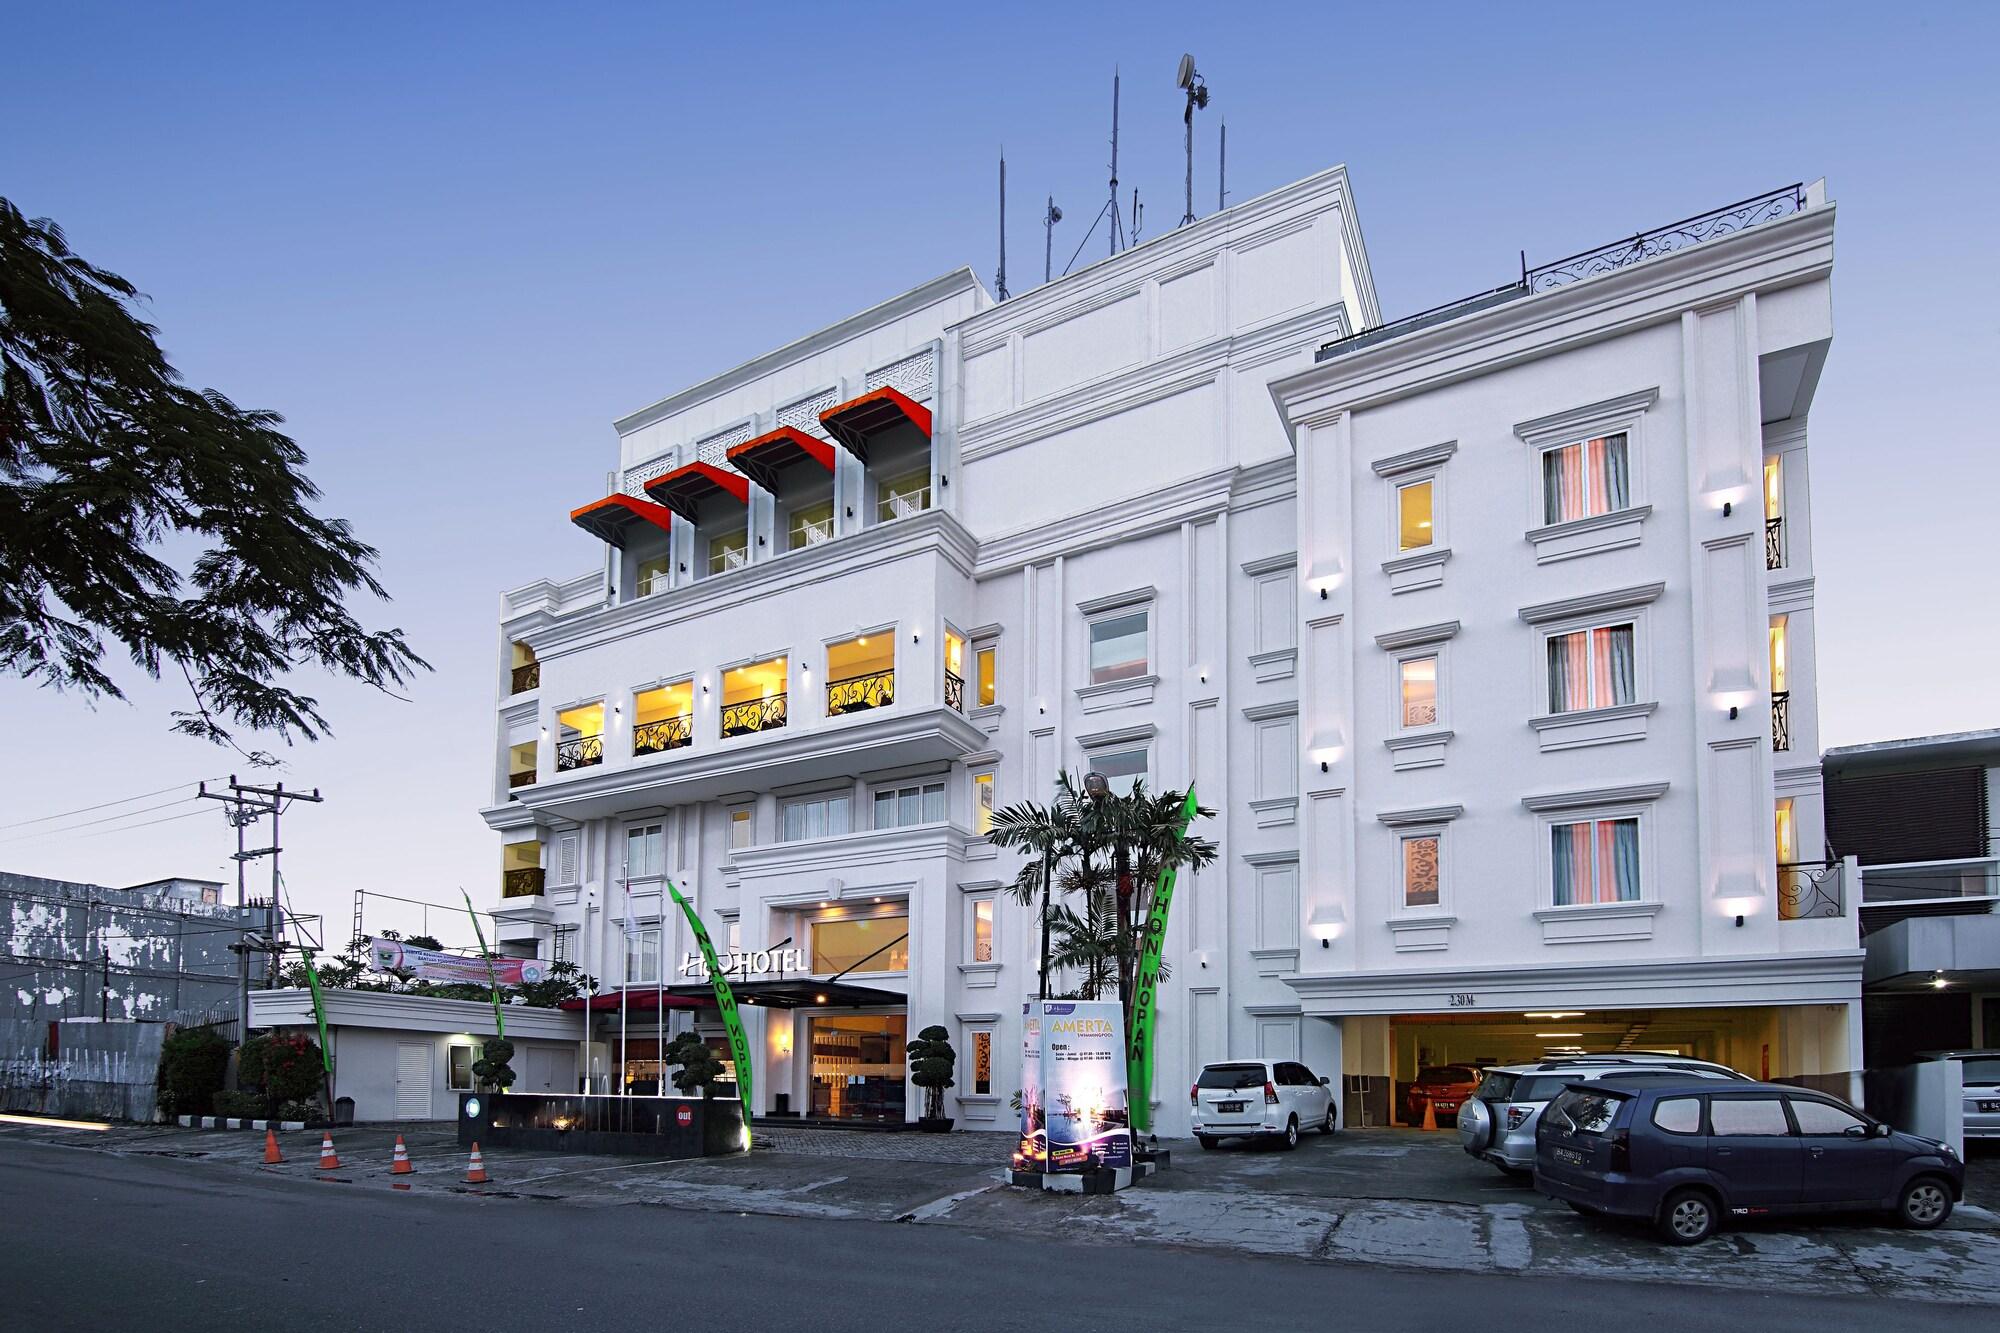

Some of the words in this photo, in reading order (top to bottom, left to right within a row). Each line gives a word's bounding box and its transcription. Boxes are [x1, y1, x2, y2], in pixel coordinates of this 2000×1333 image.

[736, 948, 808, 974] HOTEL
[1052, 1019, 1113, 1033] AMERTA
[1131, 971, 1155, 1061] NOPAN
